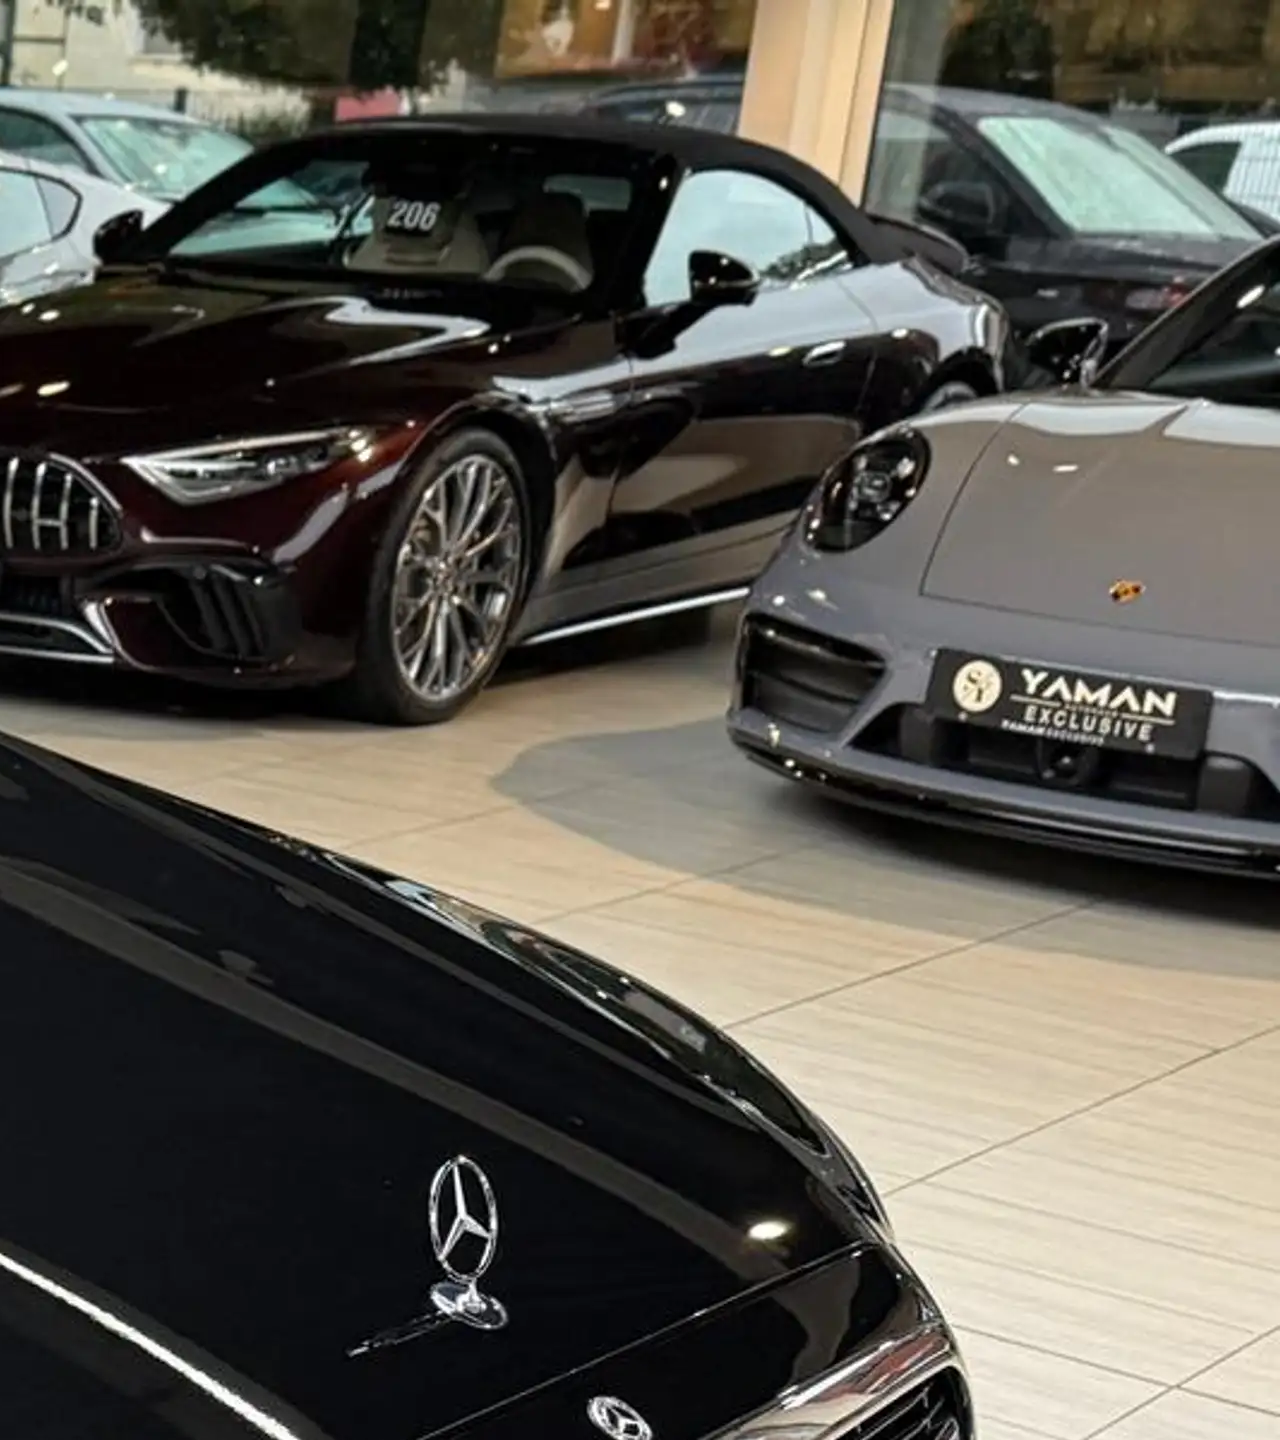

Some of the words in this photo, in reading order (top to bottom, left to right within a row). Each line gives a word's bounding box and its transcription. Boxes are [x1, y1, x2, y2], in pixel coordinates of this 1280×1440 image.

[387, 199, 441, 231] 206
[1020, 668, 1178, 717] YAMAN
[1024, 705, 1154, 742] EXCLUSIVE
